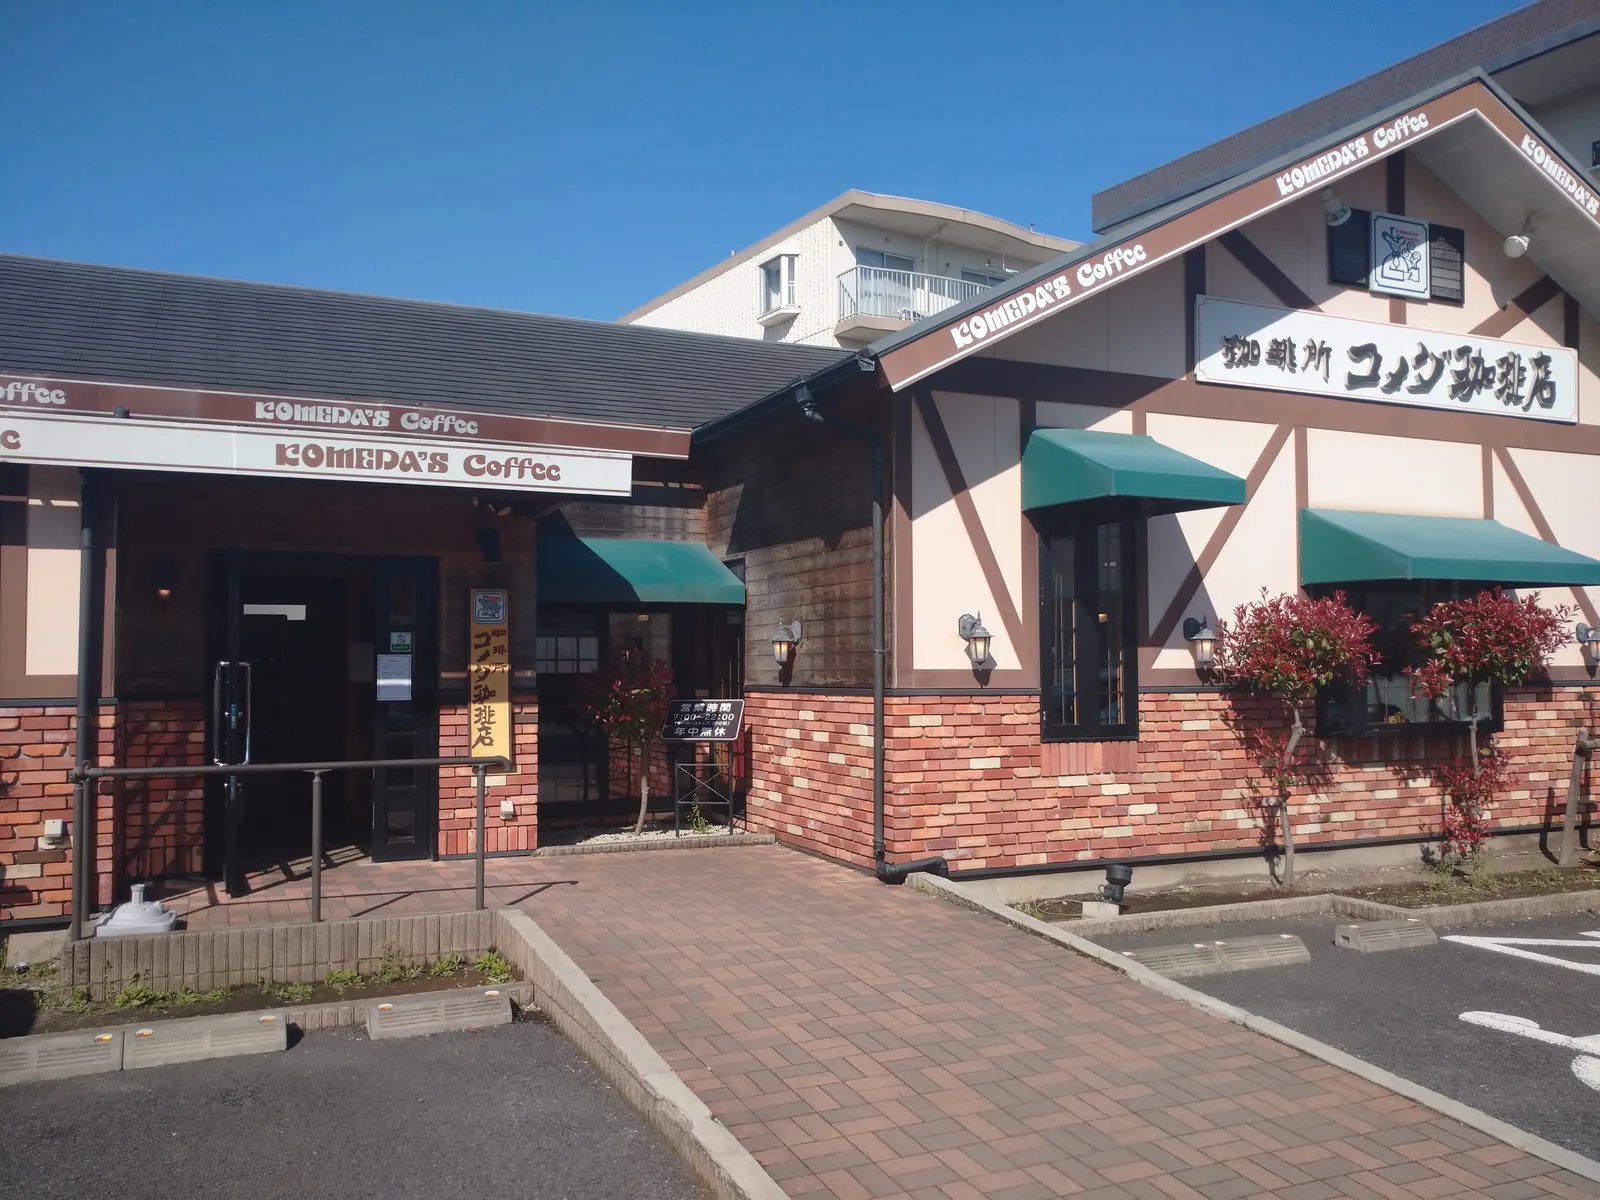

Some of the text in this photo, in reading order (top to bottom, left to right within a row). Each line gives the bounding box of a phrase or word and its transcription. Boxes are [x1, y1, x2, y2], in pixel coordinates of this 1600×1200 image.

[1276, 112, 1429, 196] KOMEDA'S Coffee
[1521, 133, 1600, 215] KOMEDA'S
[950, 244, 1148, 349] KOMEDA'S Coffee
[255, 401, 479, 435] KOMEDA'S Coffee
[275, 443, 562, 482] KOMEDA'S Coffee
[680, 702, 732, 712] 営業時間
[674, 726, 726, 737] 年中無休
